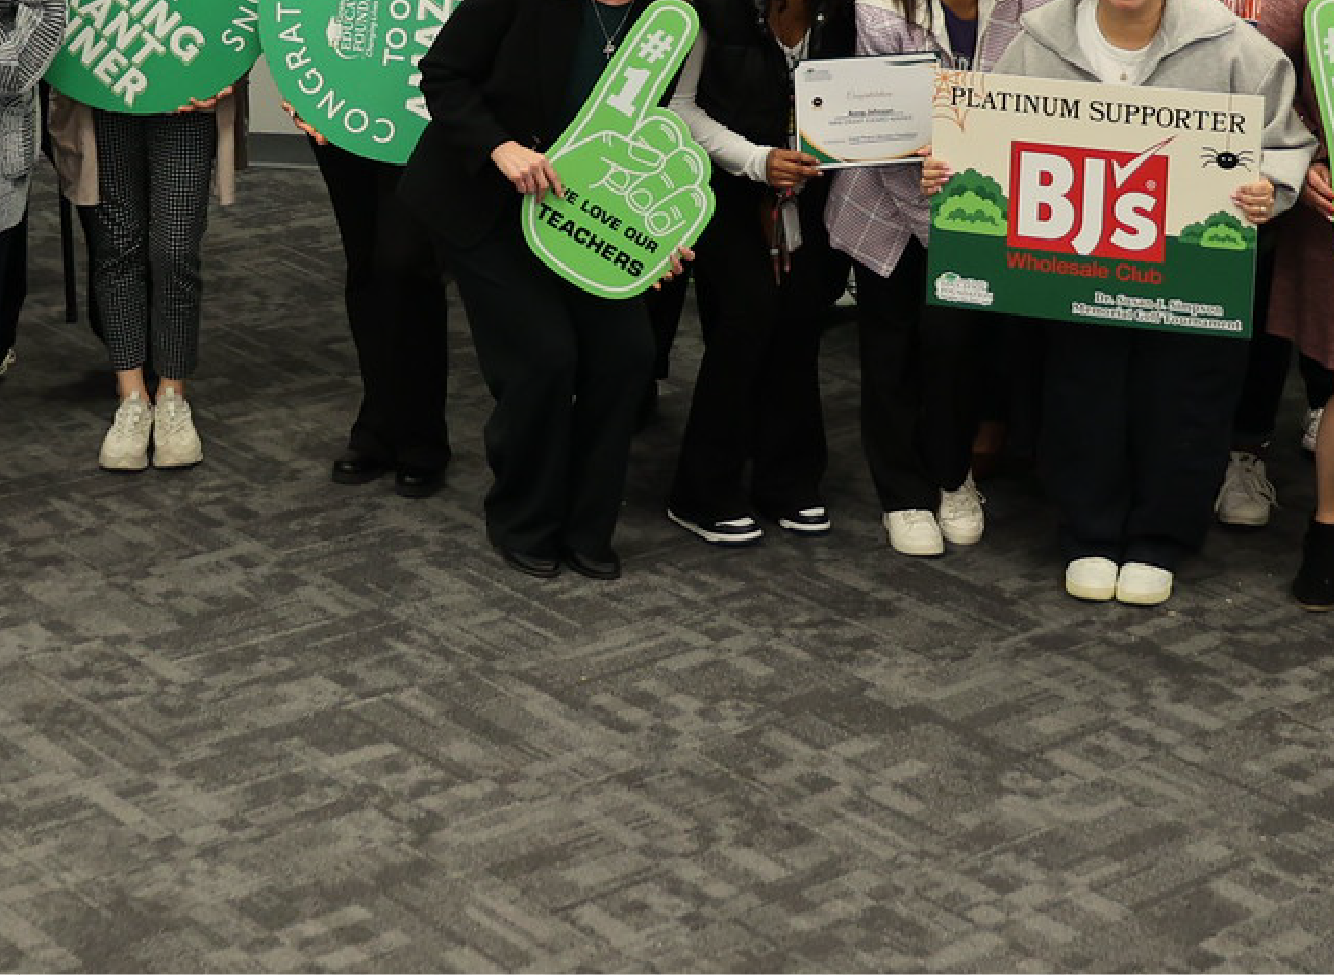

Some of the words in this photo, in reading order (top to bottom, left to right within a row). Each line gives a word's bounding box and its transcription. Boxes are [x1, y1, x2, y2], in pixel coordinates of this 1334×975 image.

[382, 27, 407, 67] TO
[949, 85, 1081, 121] PLATINUM
[1089, 100, 1247, 135] SUPPORTER
[537, 202, 645, 278] TEACHERS
[579, 199, 622, 231] LOVE
[625, 226, 659, 254] OUR
[1005, 251, 1109, 282] Wholesale
[1115, 262, 1163, 286] Club
